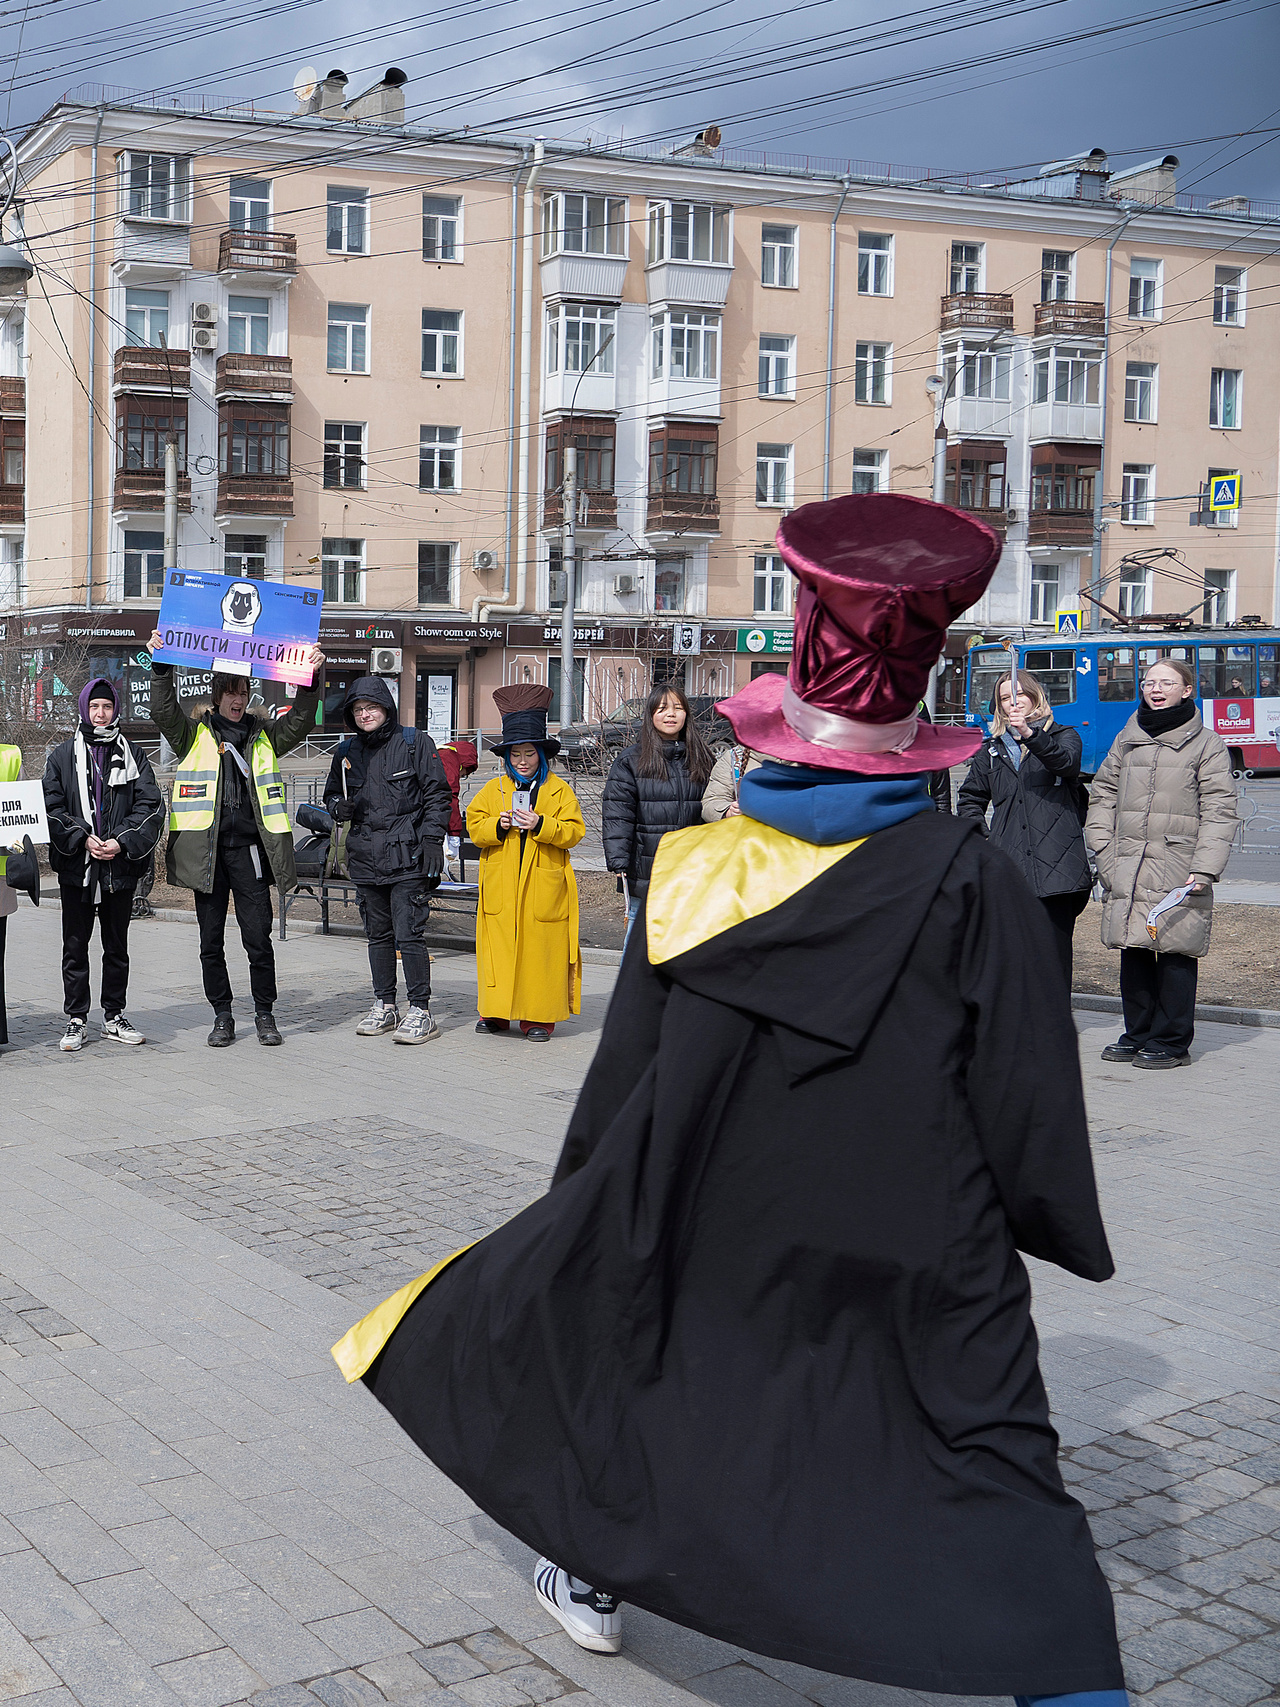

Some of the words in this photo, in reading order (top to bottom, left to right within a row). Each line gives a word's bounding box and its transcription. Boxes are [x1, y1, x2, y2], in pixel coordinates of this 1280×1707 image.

[414, 626, 464, 637] Showroom
[465, 629, 477, 638] on
[479, 627, 503, 641] Style
[543, 628, 605, 641] БРАОБРЕЙ
[165, 630, 229, 653] ОТПУСТИ
[242, 641, 305, 666] ГУСЕЙ!!!
[1, 800, 22, 813] ДЛЯ
